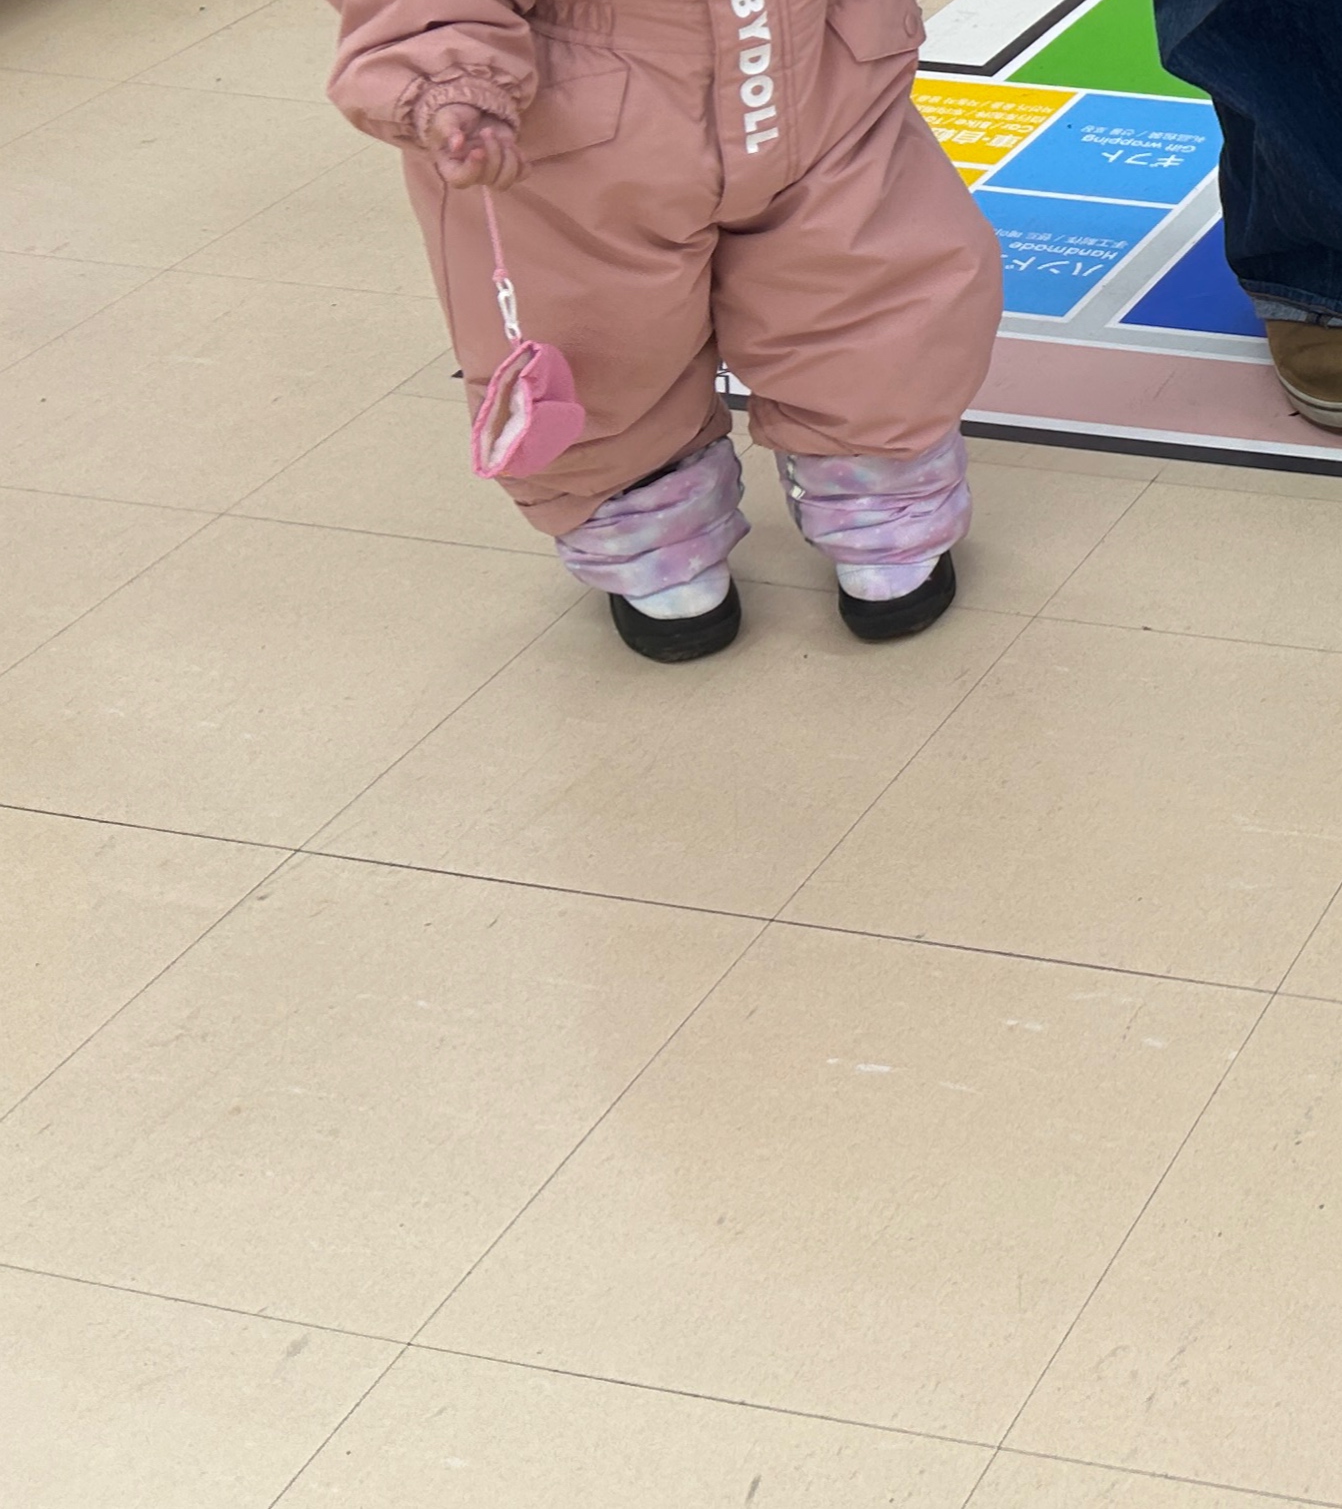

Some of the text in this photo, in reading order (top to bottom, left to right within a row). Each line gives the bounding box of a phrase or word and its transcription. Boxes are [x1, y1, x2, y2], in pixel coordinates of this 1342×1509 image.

[1082, 134, 1195, 152] Gift wrapping
[1102, 150, 1182, 167] ギフト
[1009, 241, 1116, 259] Handmade
[1000, 254, 1102, 275] ハンド
